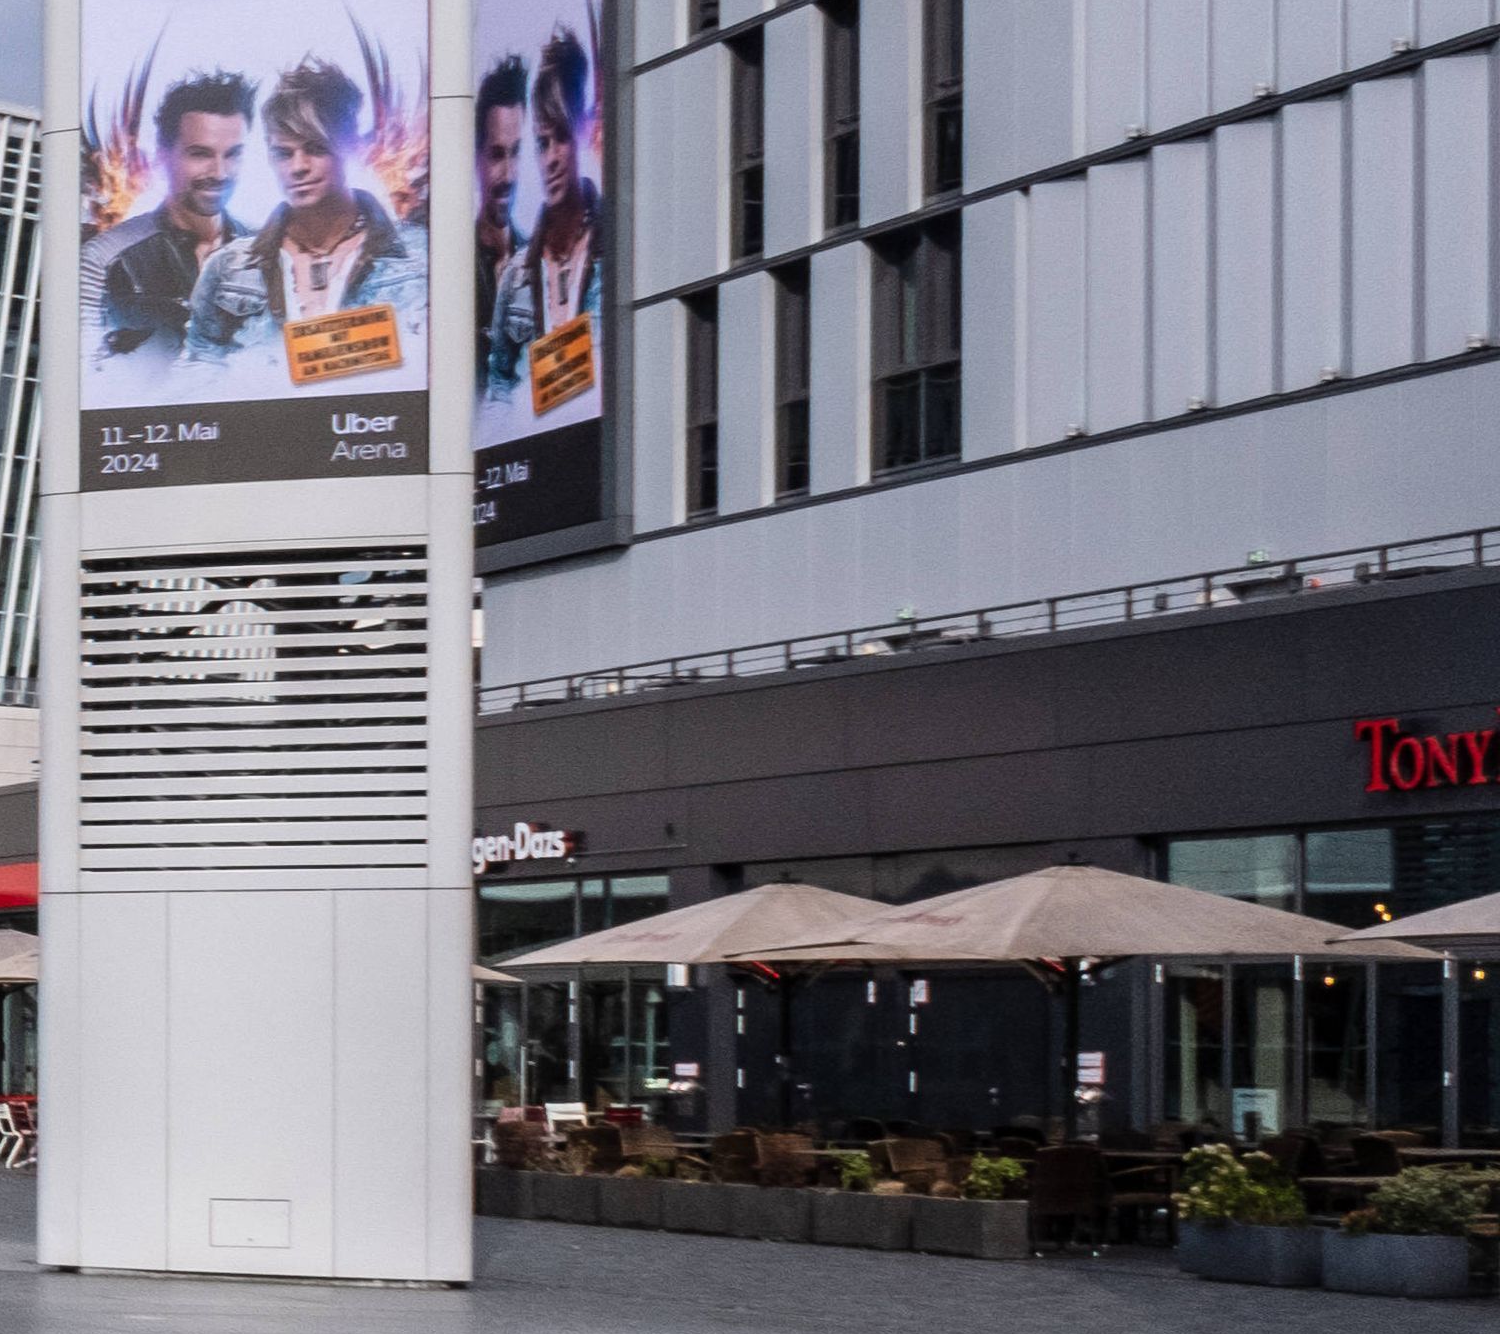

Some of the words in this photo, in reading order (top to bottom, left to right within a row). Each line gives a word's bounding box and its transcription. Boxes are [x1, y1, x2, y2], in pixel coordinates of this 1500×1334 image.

[178, 422, 220, 442] Mai
[331, 412, 398, 435] Uber
[330, 440, 406, 462] Arena
[100, 453, 159, 474] 2024
